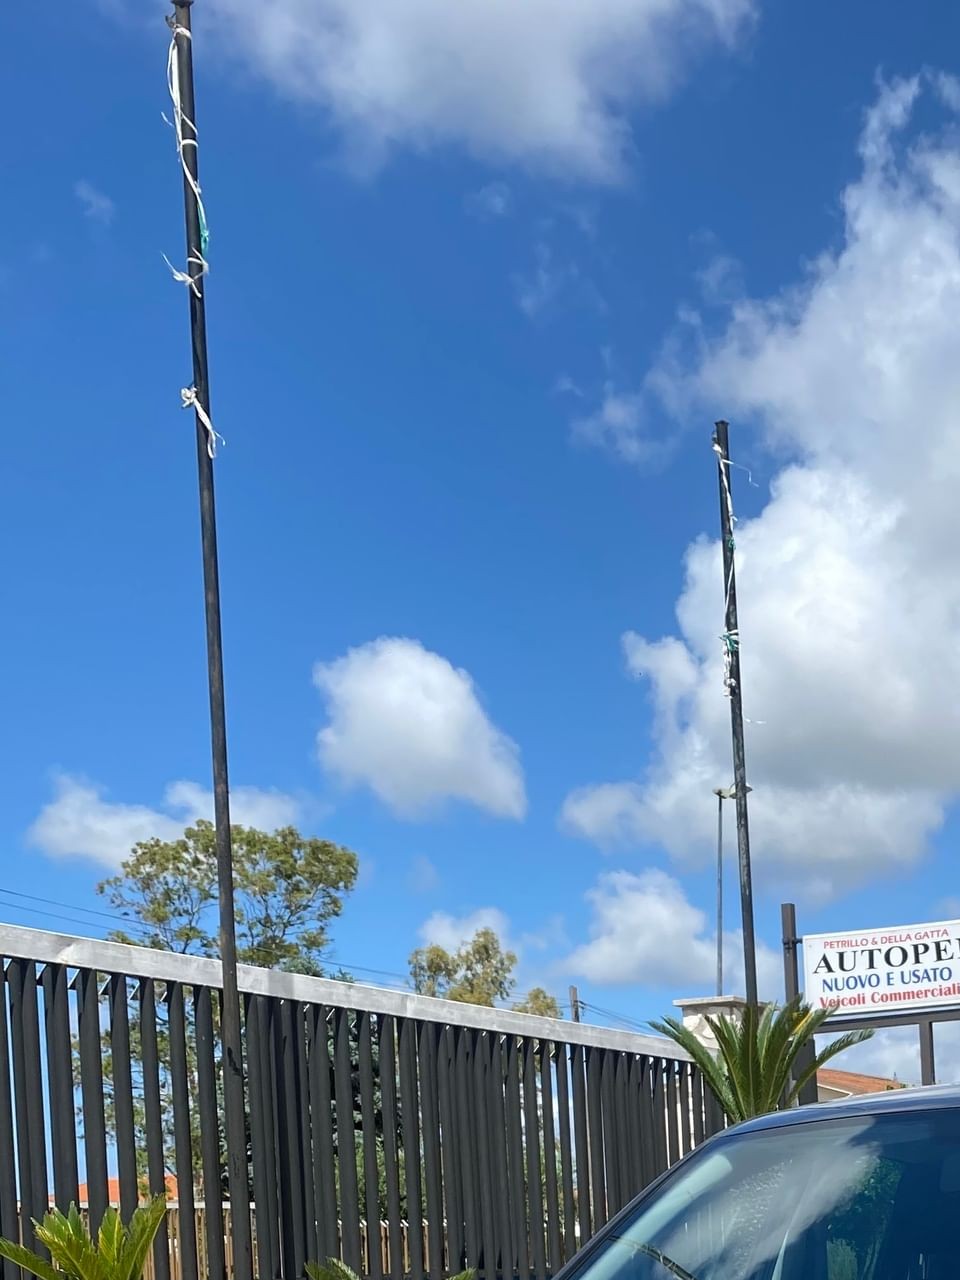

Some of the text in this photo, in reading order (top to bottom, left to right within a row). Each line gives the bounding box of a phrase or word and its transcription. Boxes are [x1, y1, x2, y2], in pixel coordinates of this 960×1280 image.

[823, 928, 949, 949] PETRILLO & DELLA GATTA
[822, 966, 953, 993] NUOVO E USATO
[820, 983, 960, 1009] Veicoli Commerciali
